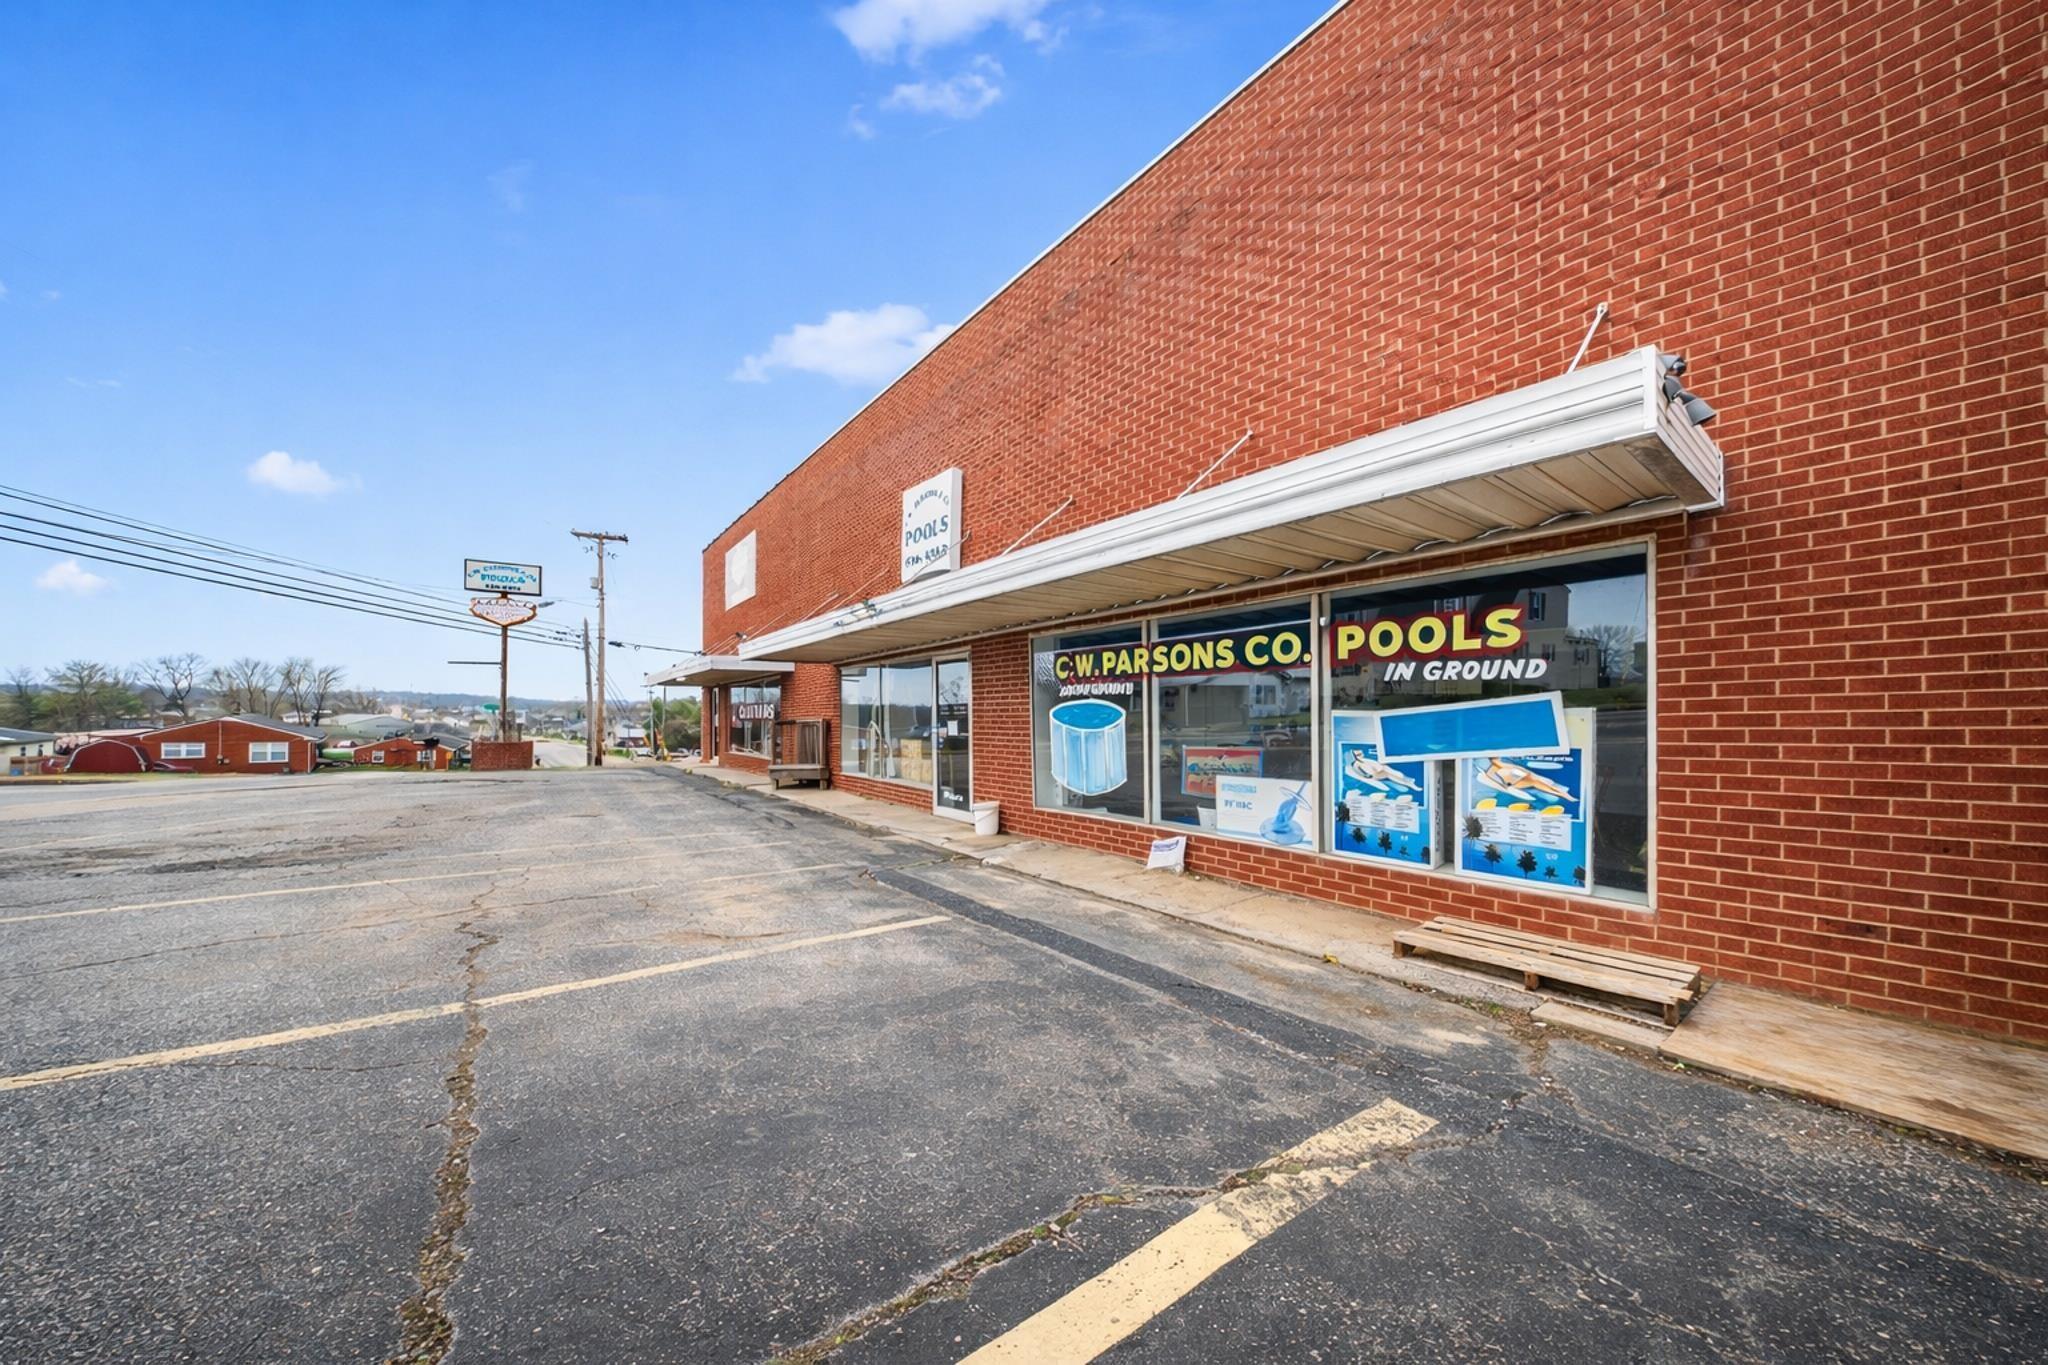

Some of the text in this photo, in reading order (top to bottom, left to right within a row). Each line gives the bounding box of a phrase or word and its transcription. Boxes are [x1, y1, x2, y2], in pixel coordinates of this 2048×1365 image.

[905, 515, 949, 547] POOLS
[1337, 608, 1523, 660] POOLS
[1101, 638, 1236, 676] PARSONS
[1244, 631, 1312, 666] CO.
[1383, 658, 1548, 682] IN GROUND
